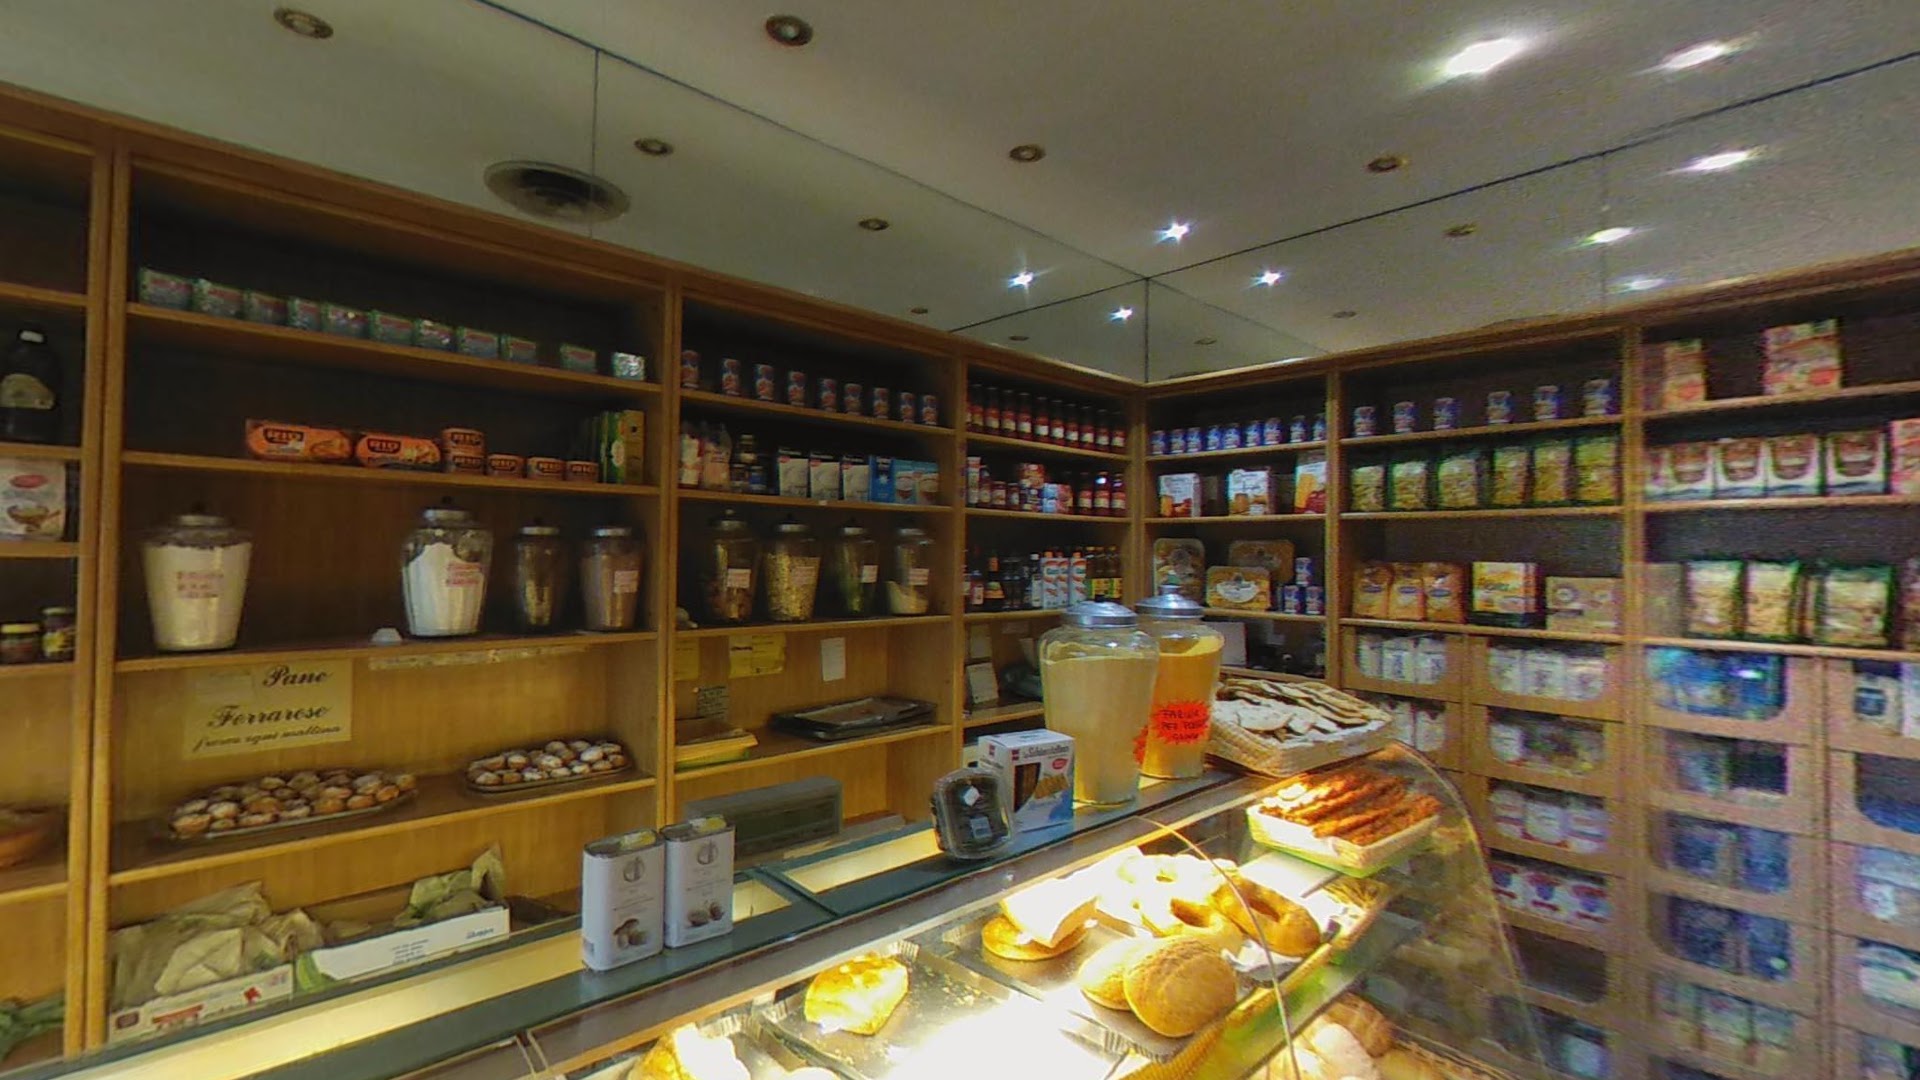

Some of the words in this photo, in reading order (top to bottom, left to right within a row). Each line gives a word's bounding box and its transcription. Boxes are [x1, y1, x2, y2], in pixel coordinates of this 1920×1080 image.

[369, 439, 399, 450] RIO
[262, 665, 332, 687] Pane
[206, 704, 331, 728] Ferrarese
